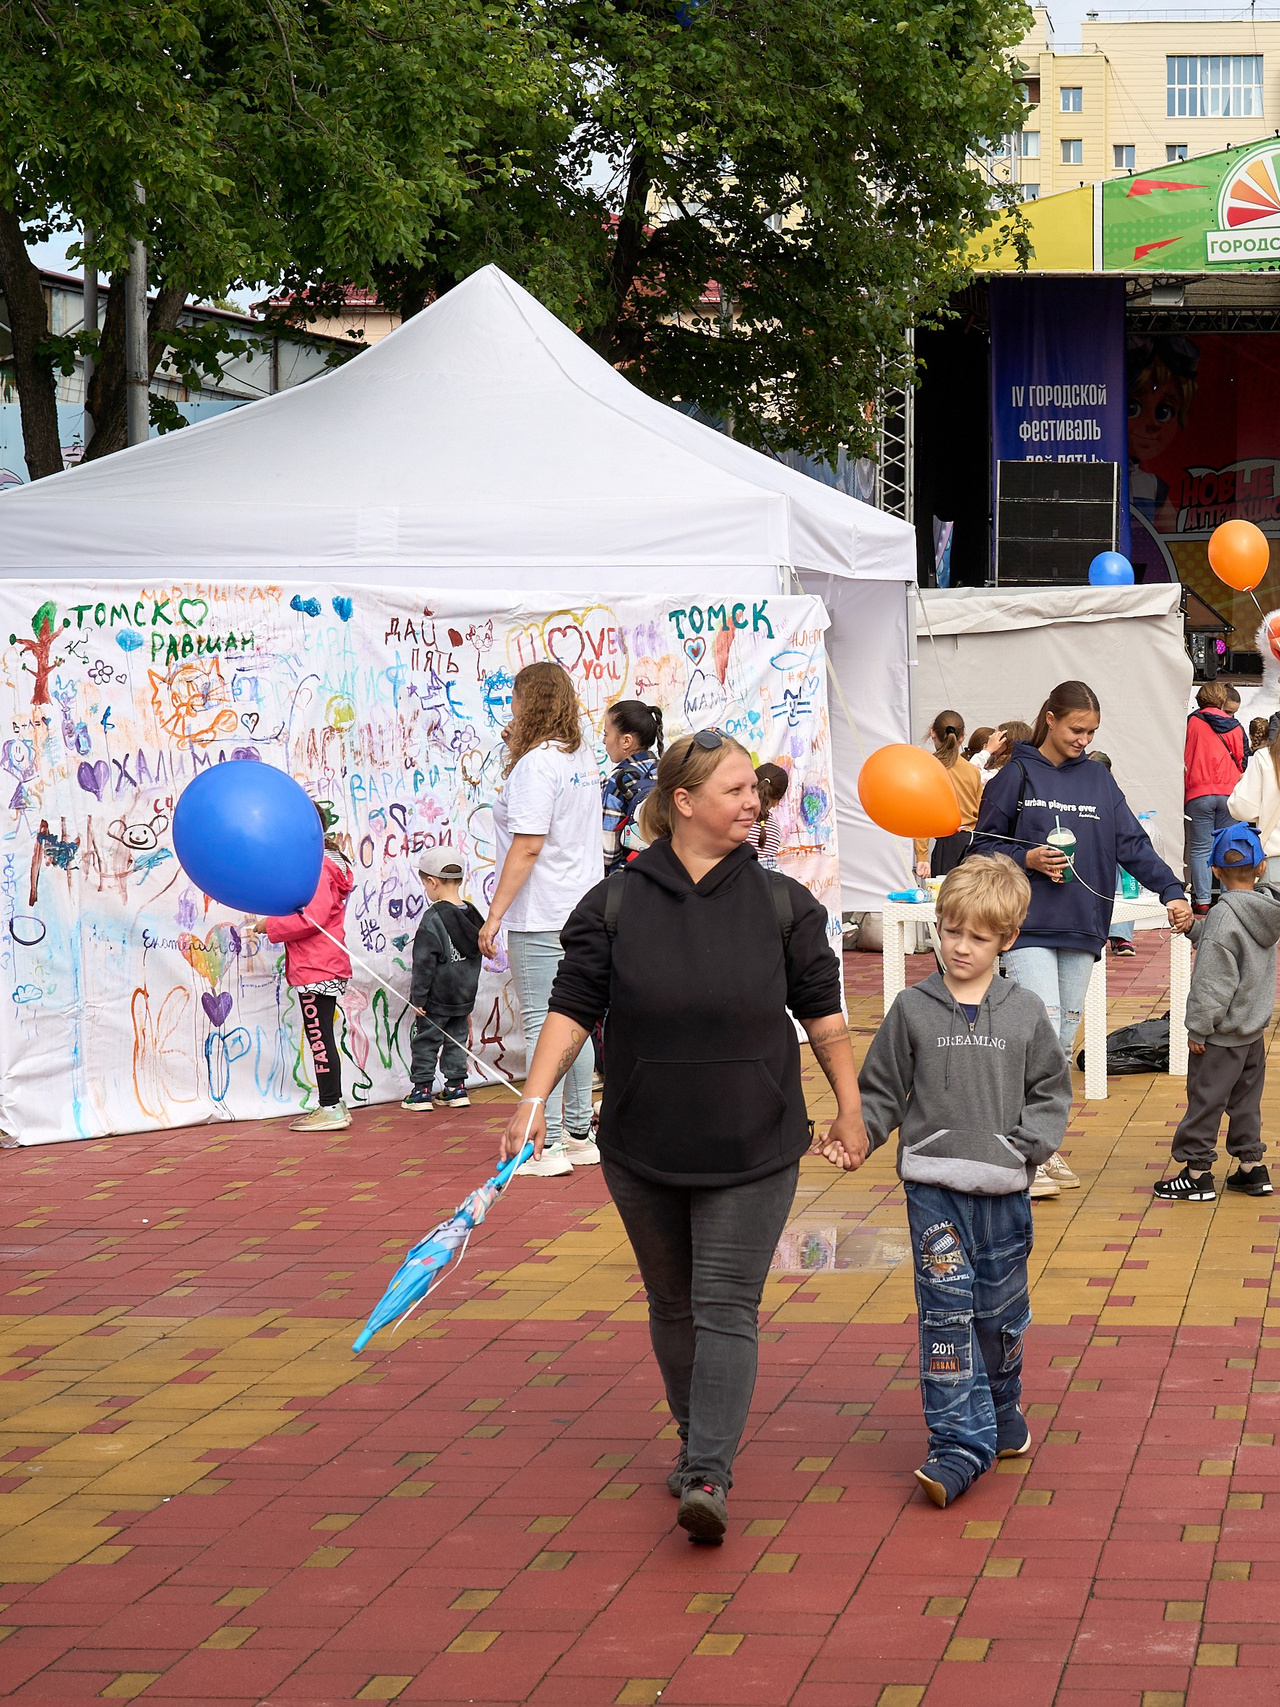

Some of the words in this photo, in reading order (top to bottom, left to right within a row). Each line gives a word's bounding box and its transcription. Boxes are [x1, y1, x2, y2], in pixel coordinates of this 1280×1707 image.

[1011, 386, 1025, 407] IV
[1029, 384, 1107, 408] ГОРОДСКОЙ
[1181, 466, 1275, 509] НОВЫЕ
[68, 598, 173, 629] ТОМСК
[669, 599, 775, 640] ТОМСК
[152, 631, 255, 666] РАВШАН
[411, 648, 459, 675] ПЯТЬ
[582, 658, 621, 681] YOU
[350, 767, 406, 803] ВАРЯ
[302, 992, 331, 1074] FABULOU
[937, 1034, 1006, 1050] DREAMING
[932, 1342, 955, 1355] 2011
